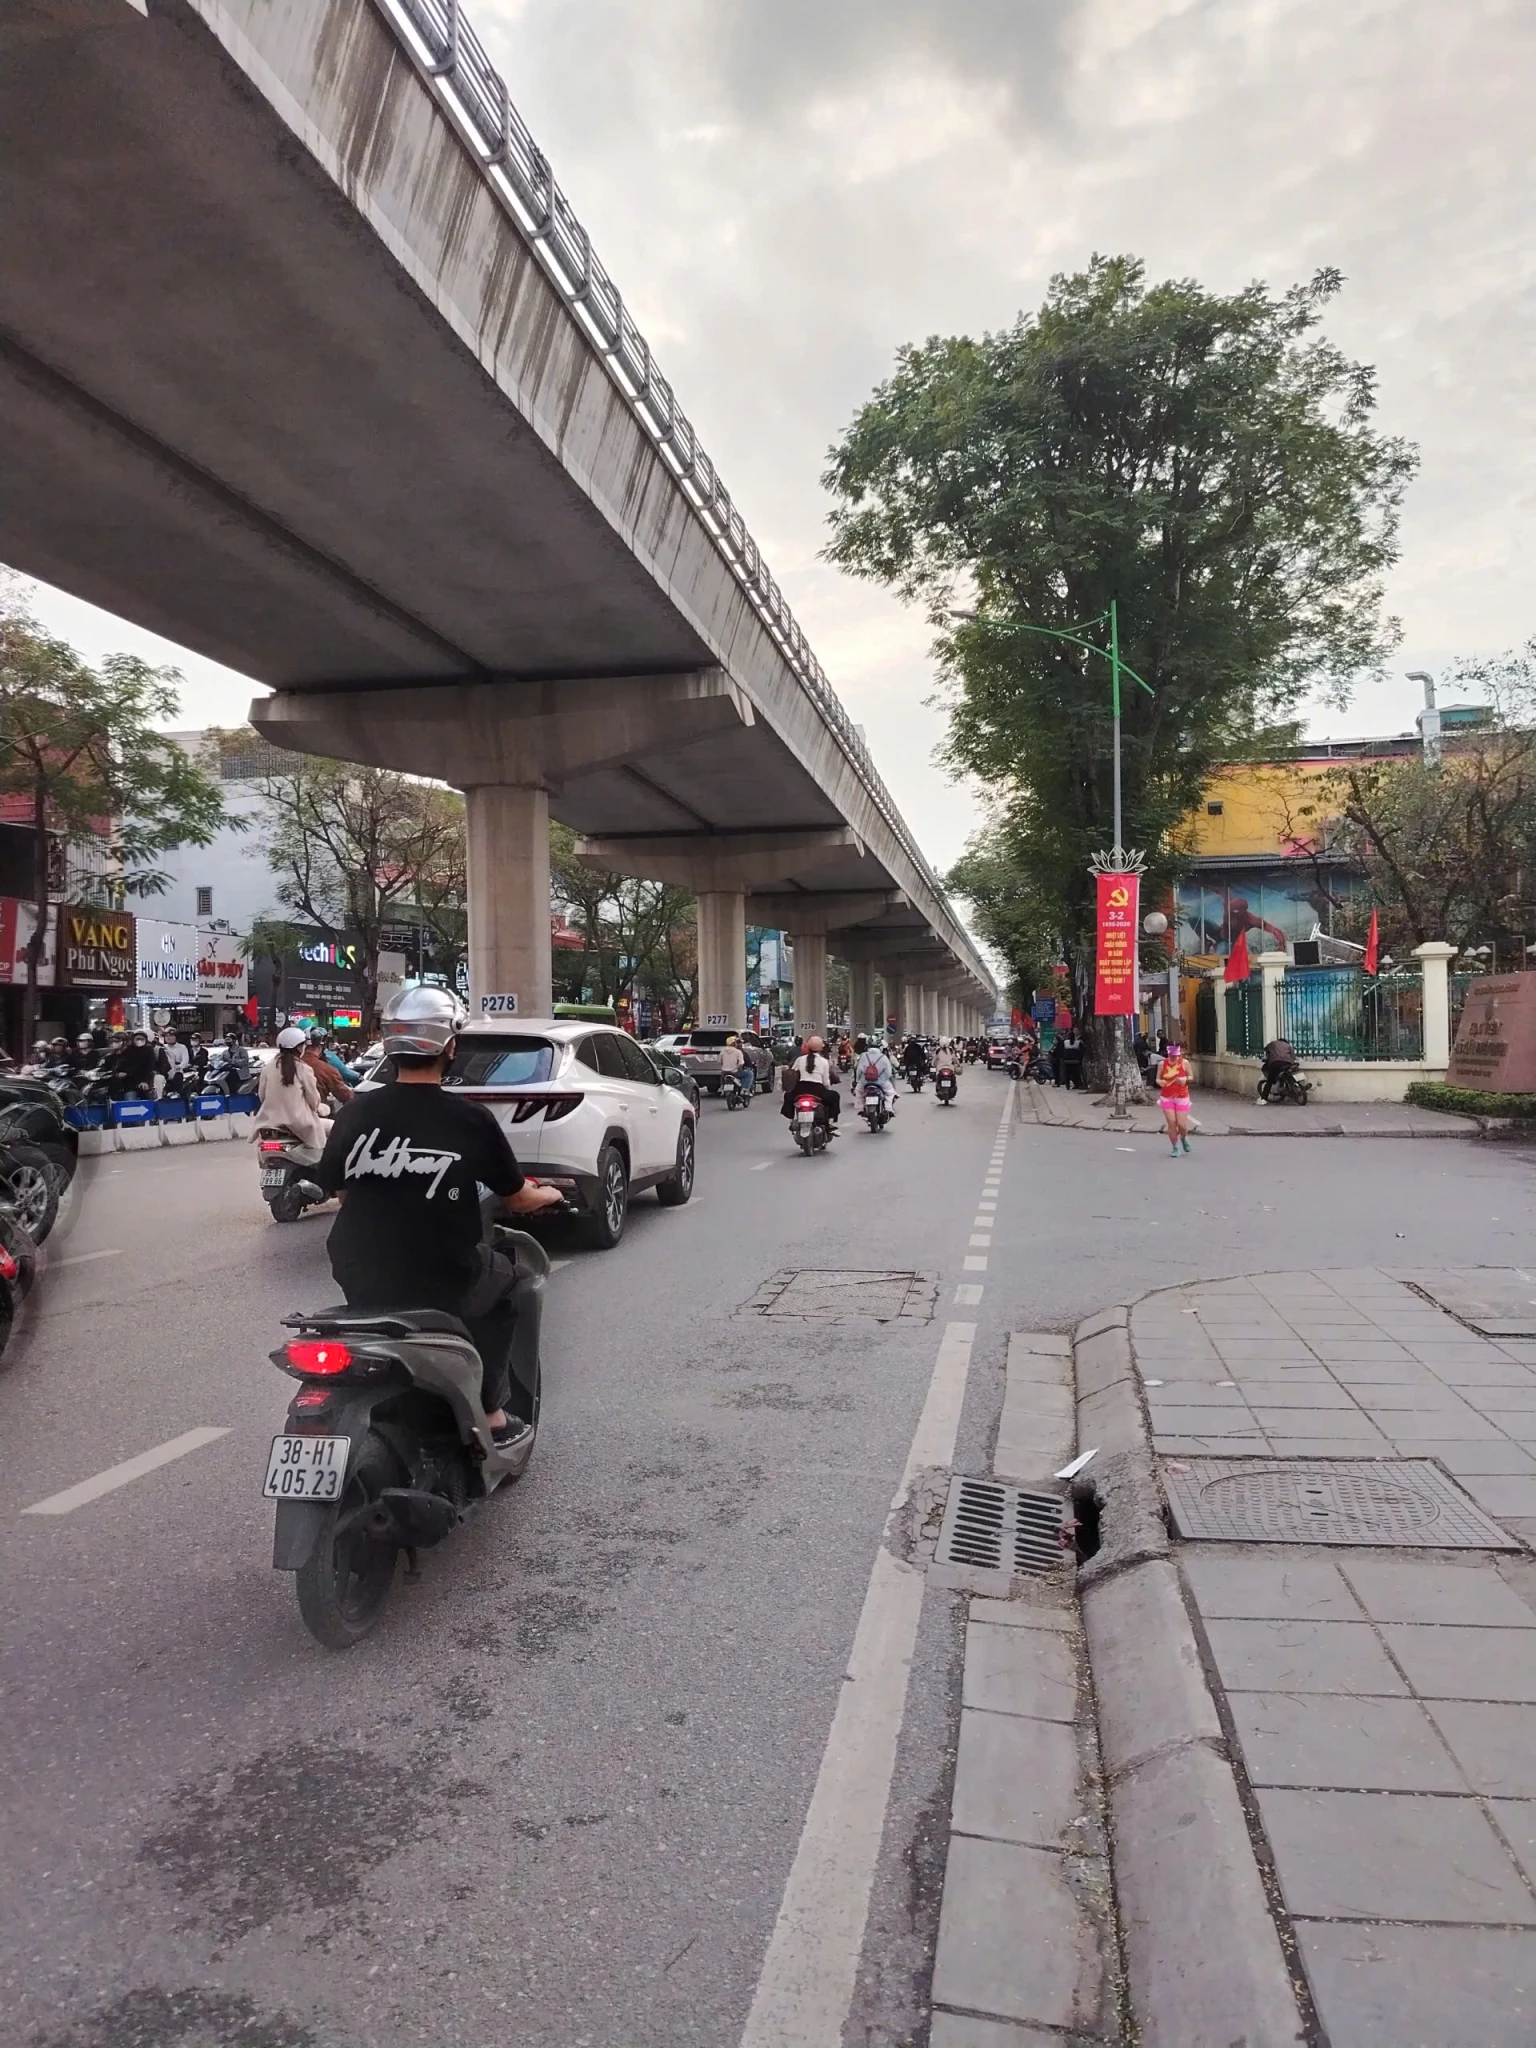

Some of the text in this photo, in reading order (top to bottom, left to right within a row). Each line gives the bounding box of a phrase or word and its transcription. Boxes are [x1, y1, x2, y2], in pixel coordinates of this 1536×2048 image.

[1109, 911, 1124, 920] 3-2
[66, 948, 133, 978] Phú Ngọc
[141, 957, 196, 981] HUY NGUYỄN
[204, 981, 226, 991] beautiful
[481, 995, 515, 1012] P278
[707, 1015, 727, 1025] P277
[280, 1439, 335, 1466] 38-H1
[268, 1468, 337, 1496] 405.23
